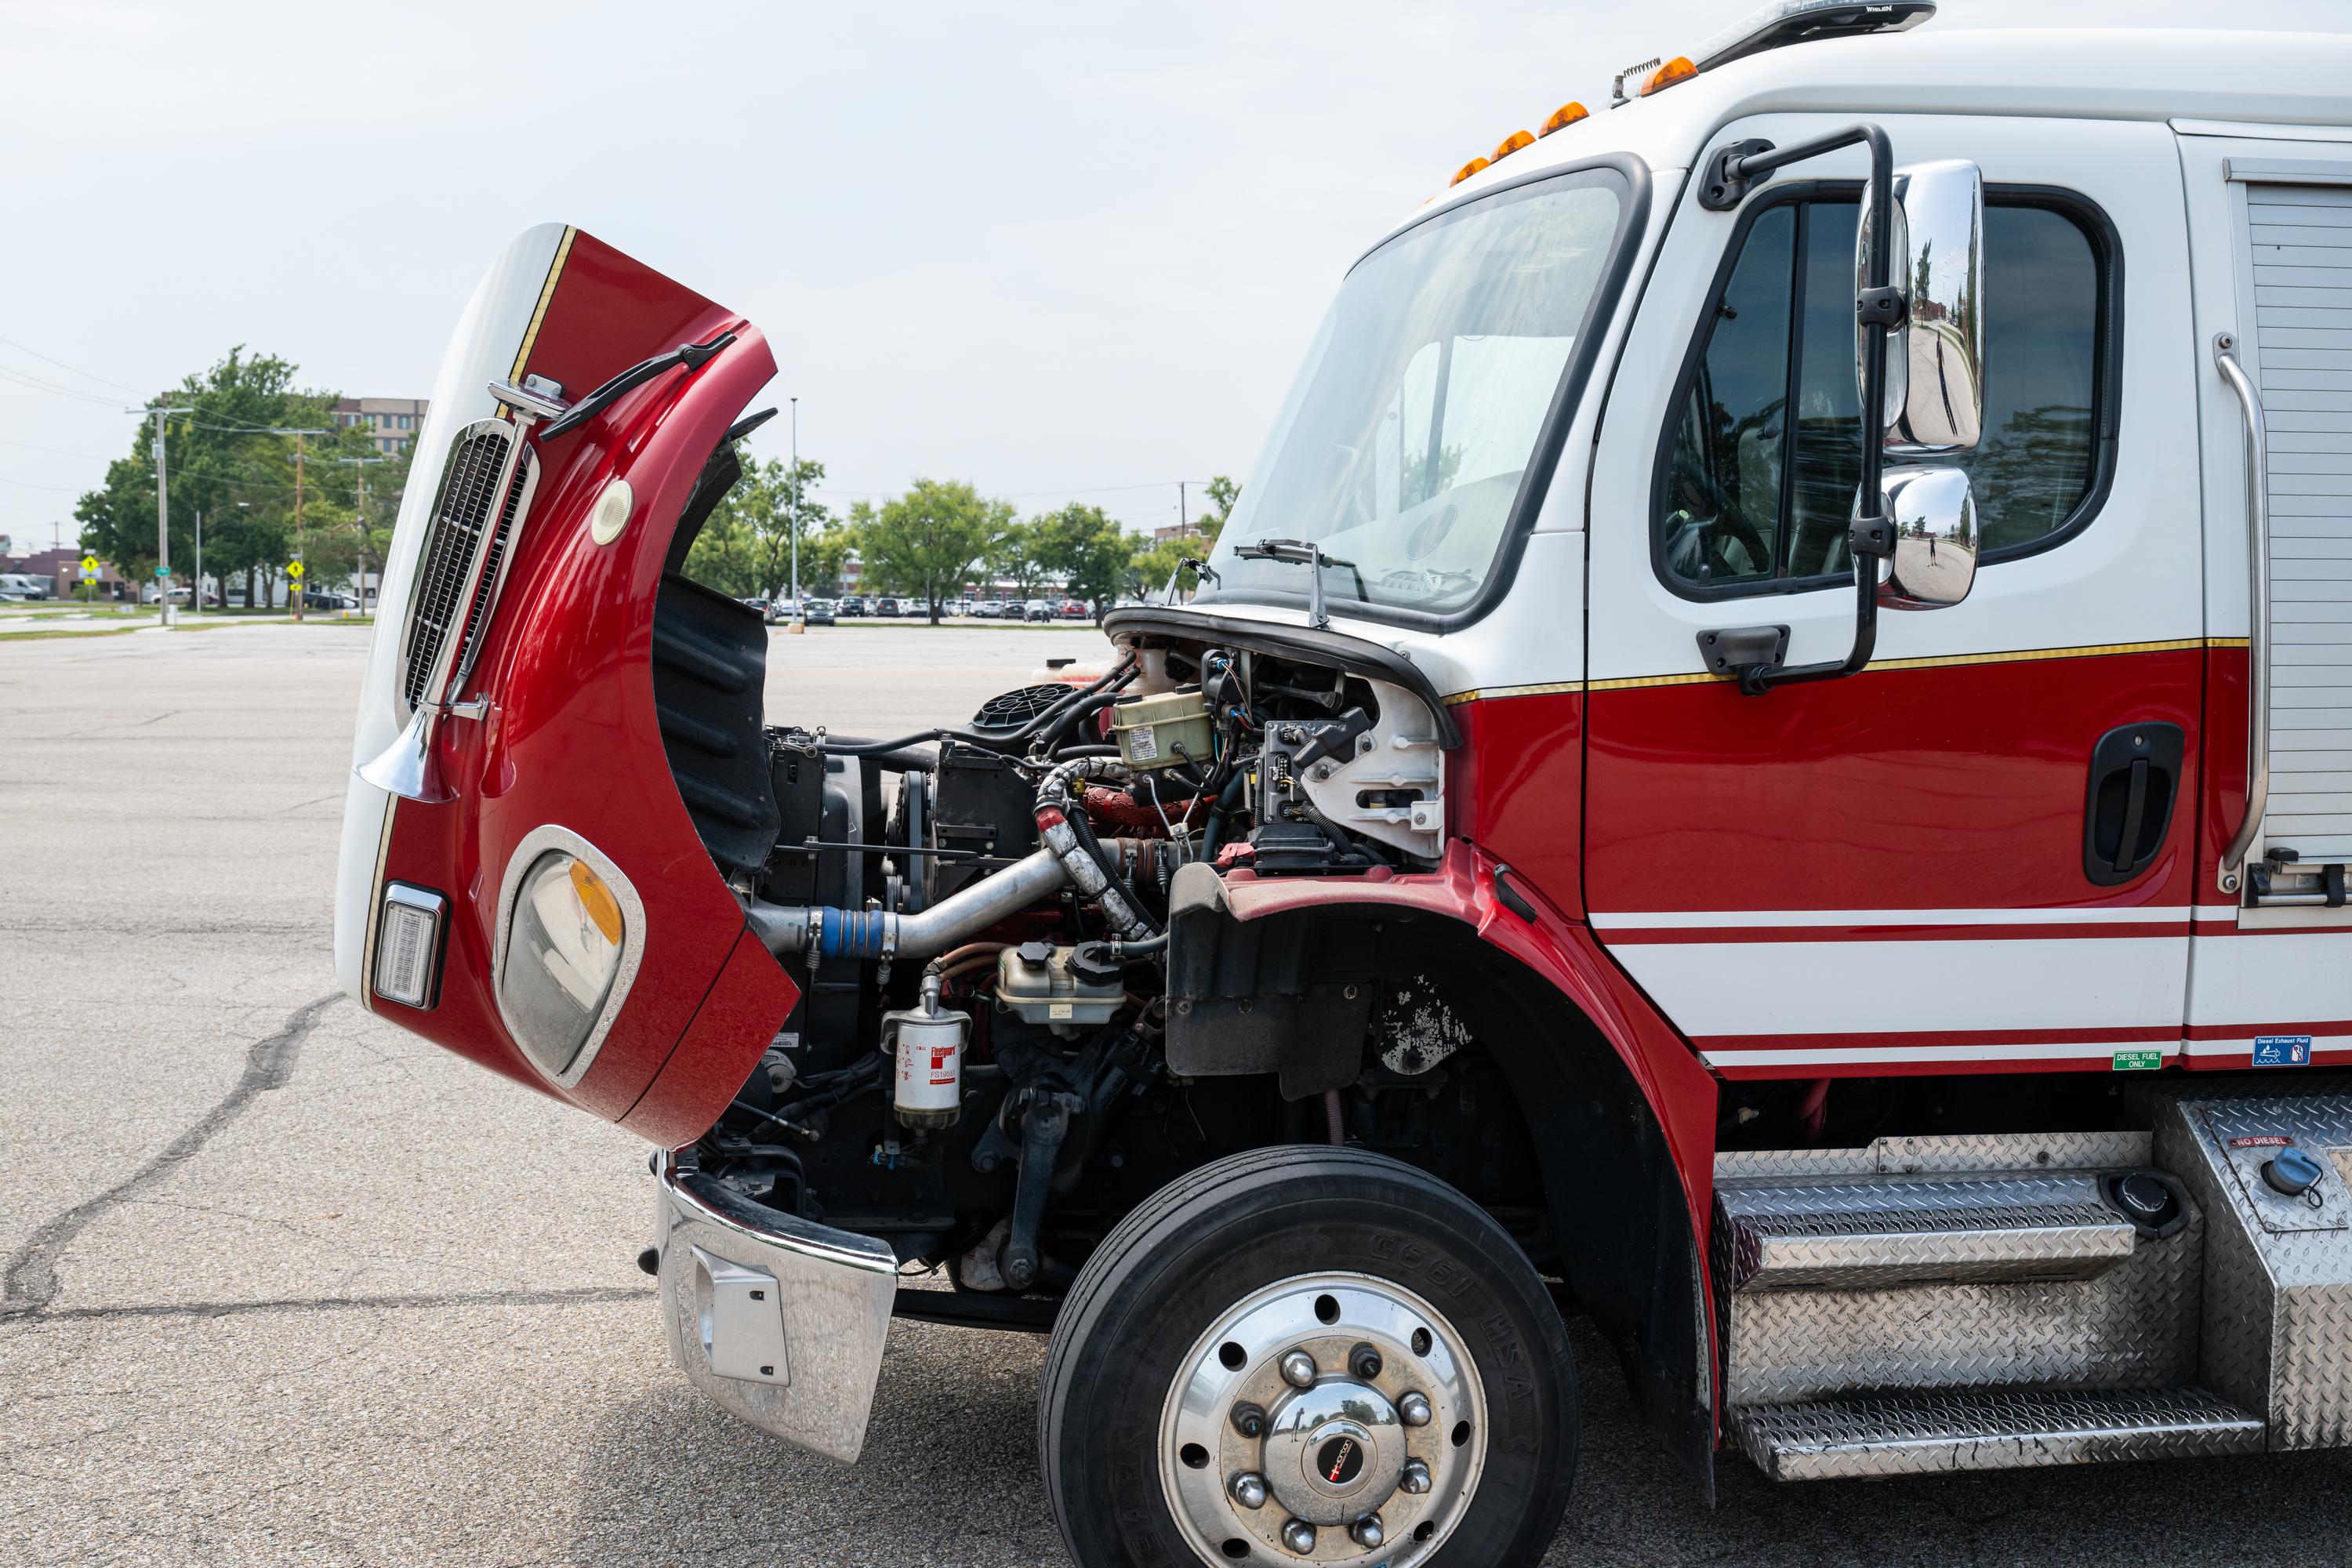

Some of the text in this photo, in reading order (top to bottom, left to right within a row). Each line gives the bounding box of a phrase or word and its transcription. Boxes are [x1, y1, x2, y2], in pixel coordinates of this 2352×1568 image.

[931, 1045, 956, 1058] Fleetguard
[930, 1069, 956, 1078] FS19551
[2236, 1136, 2287, 1146] NO DIESEL
[1369, 1233, 1535, 1403] G661 HSA
[1334, 1439, 1353, 1468] Horton
